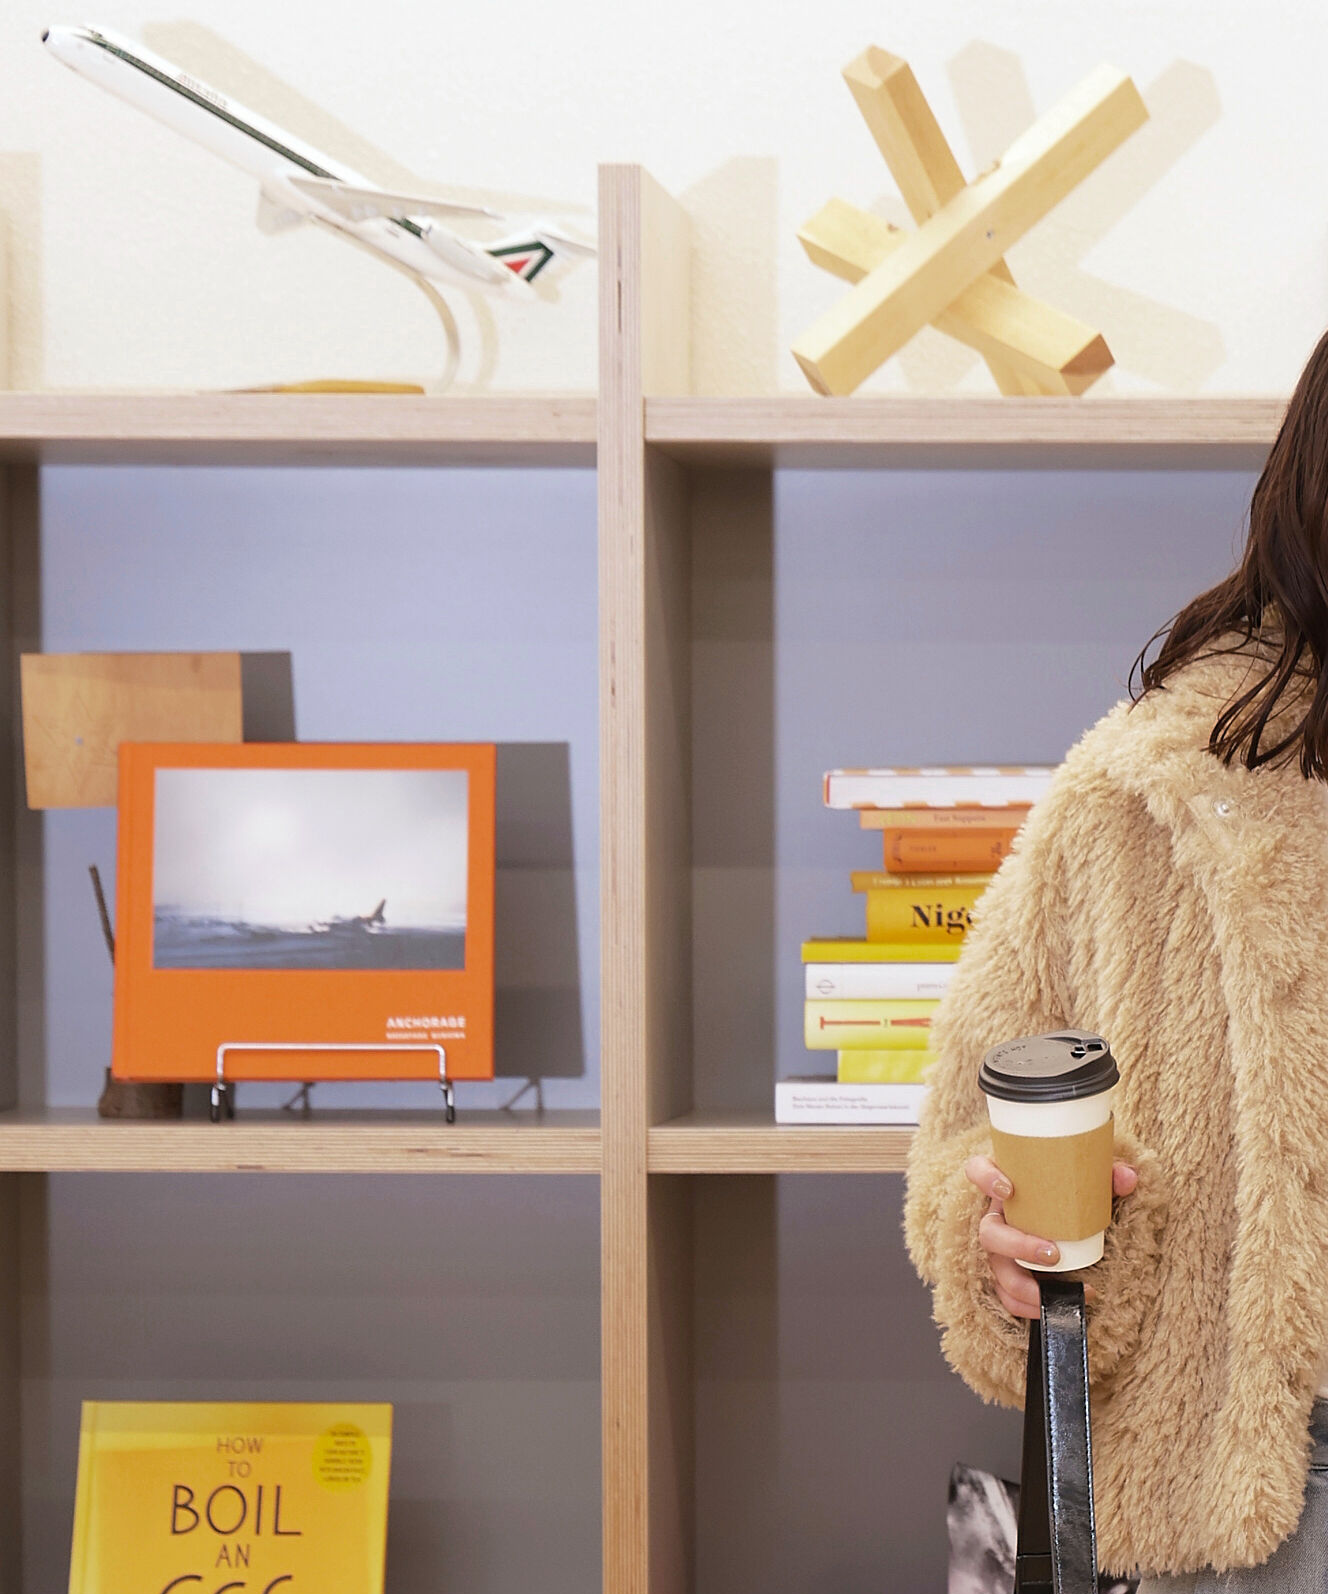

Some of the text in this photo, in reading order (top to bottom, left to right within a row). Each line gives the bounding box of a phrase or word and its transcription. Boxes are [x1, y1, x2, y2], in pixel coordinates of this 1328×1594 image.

[386, 1015, 466, 1029] ANCHORAGE
[216, 1437, 264, 1454] HOW
[228, 1460, 251, 1478] TO
[171, 1484, 302, 1536] BOIL
[215, 1543, 250, 1568] AN
